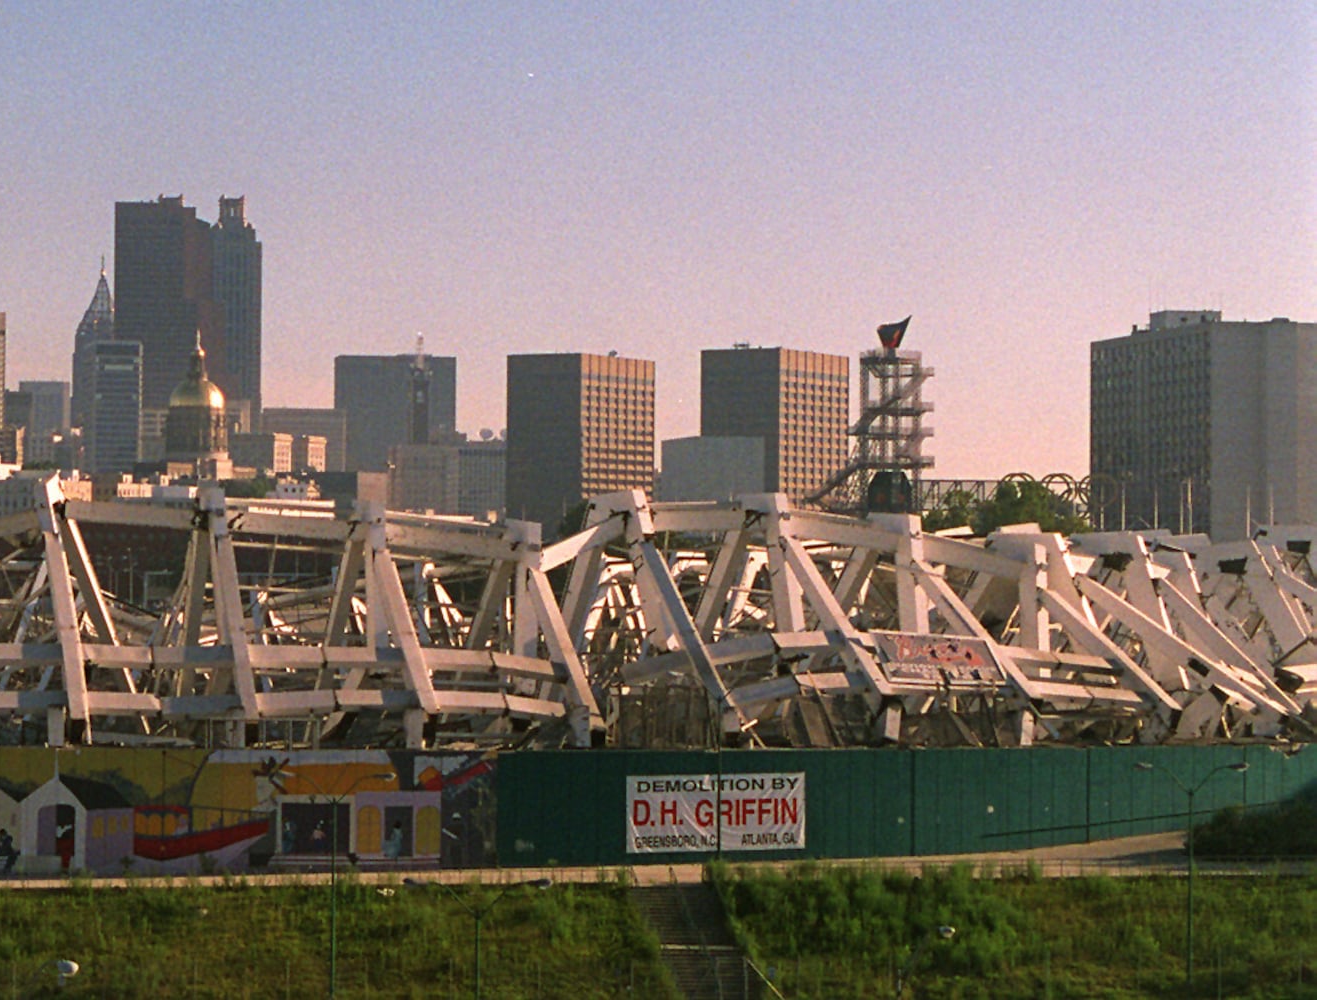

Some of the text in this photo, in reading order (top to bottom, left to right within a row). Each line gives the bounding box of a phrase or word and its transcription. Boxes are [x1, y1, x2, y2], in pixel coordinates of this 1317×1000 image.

[637, 777, 798, 792] DEMOLITION BY
[633, 797, 798, 828] D.H. GRIFFIN
[635, 834, 699, 849] GREENSBORO,
[742, 832, 781, 846] ATLANTA,
